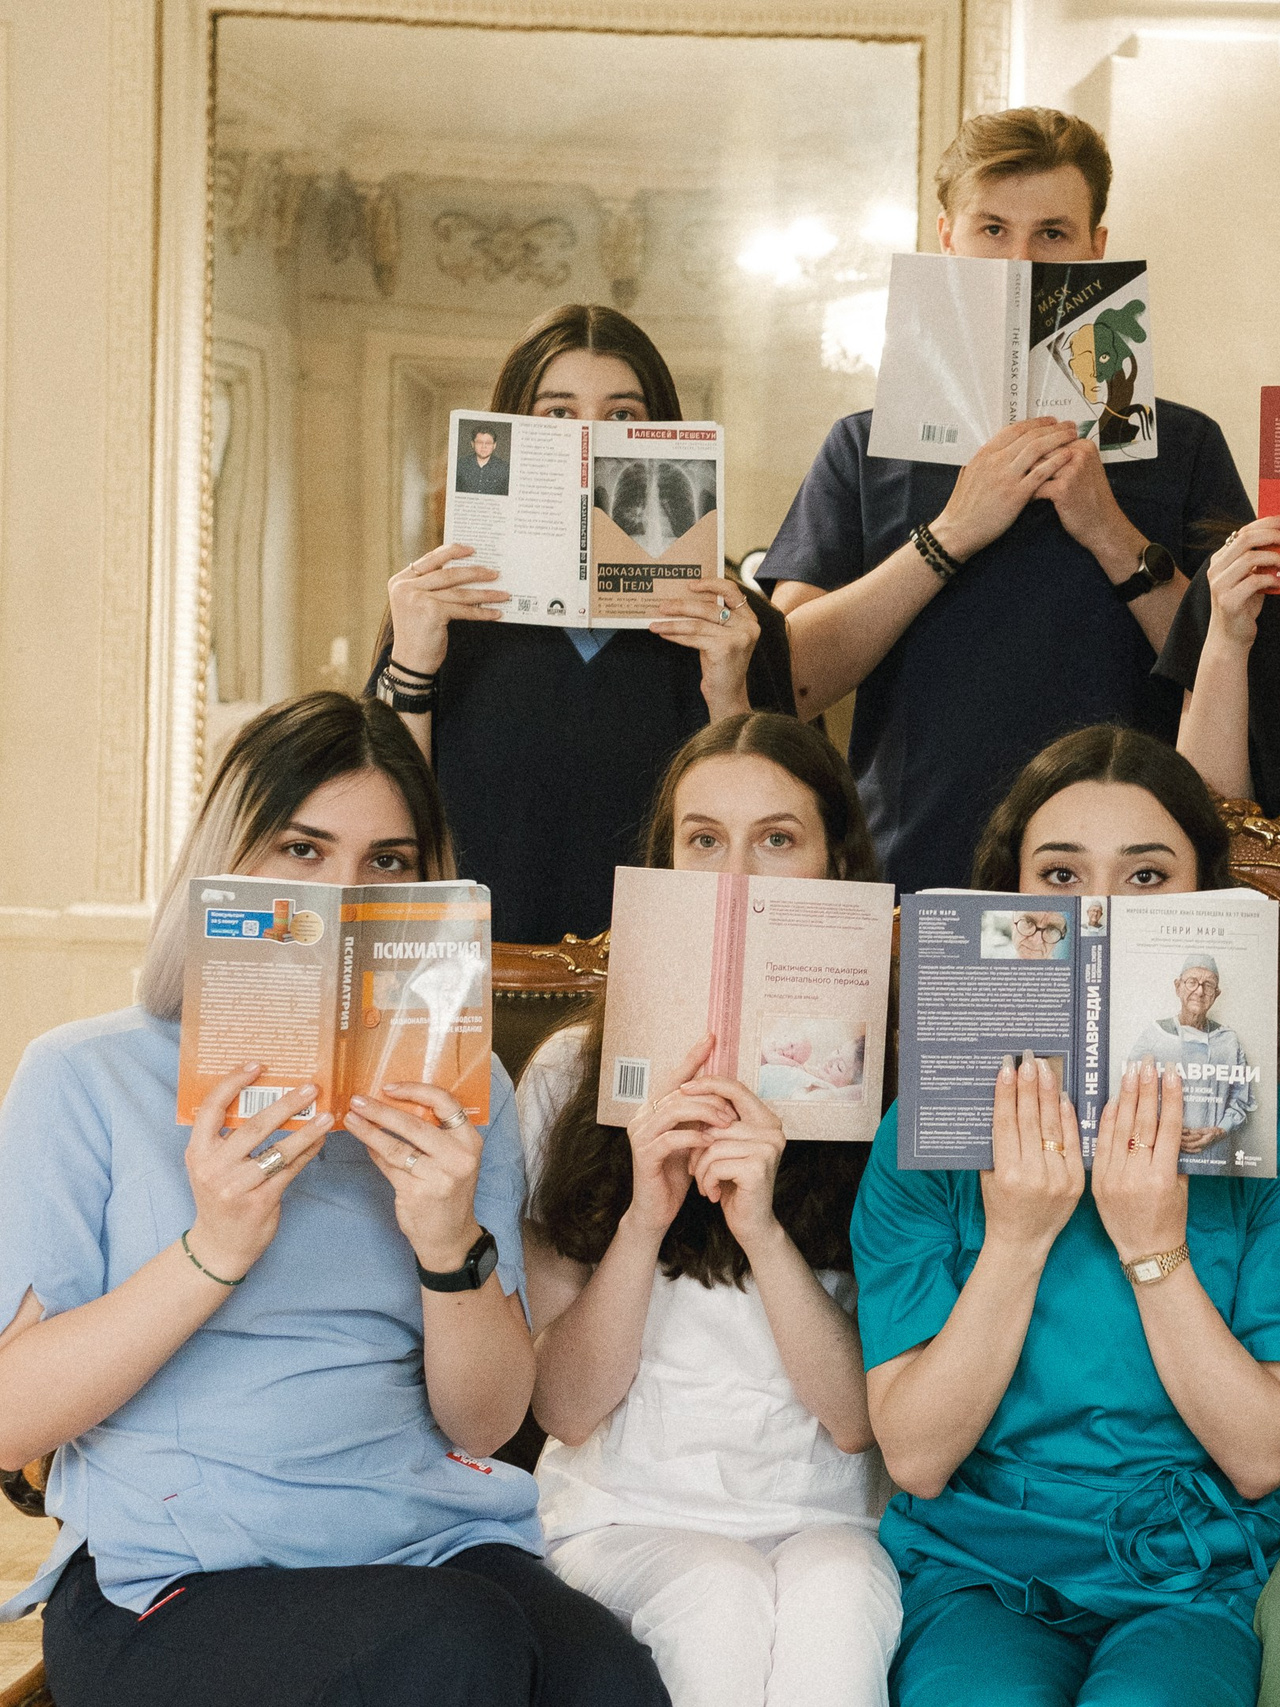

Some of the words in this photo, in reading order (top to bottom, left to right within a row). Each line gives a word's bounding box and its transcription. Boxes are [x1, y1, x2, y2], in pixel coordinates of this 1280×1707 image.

[1037, 283, 1072, 314] MASK
[1045, 317, 1055, 328] OF
[1057, 279, 1103, 318] SANITY
[1012, 327, 1020, 346] THE
[1011, 350, 1019, 379] MASK
[1010, 382, 1018, 397] OF
[634, 429, 672, 438] АЛЕКСЕЙ
[580, 494, 588, 548] ДОКАЗАТЕЛЬСТВО
[598, 566, 701, 578] ДОКАЗАТЕЛЬСТВО
[598, 580, 613, 590] ПО
[623, 581, 653, 590] ТЕЛУ
[1160, 925, 1191, 934] ГЕНРИ
[1197, 927, 1225, 937] МАРШ
[373, 941, 481, 959] ПСИХИАТРИЯ
[766, 961, 822, 973] Практическая
[825, 966, 868, 975] педиатрия
[340, 936, 354, 1031] ПСИХИАТРИЯ
[765, 974, 831, 985] перинатального
[834, 977, 870, 987] периода
[1085, 985, 1102, 1067] НАВРЕДИ
[1084, 1071, 1099, 1095] НЕ
